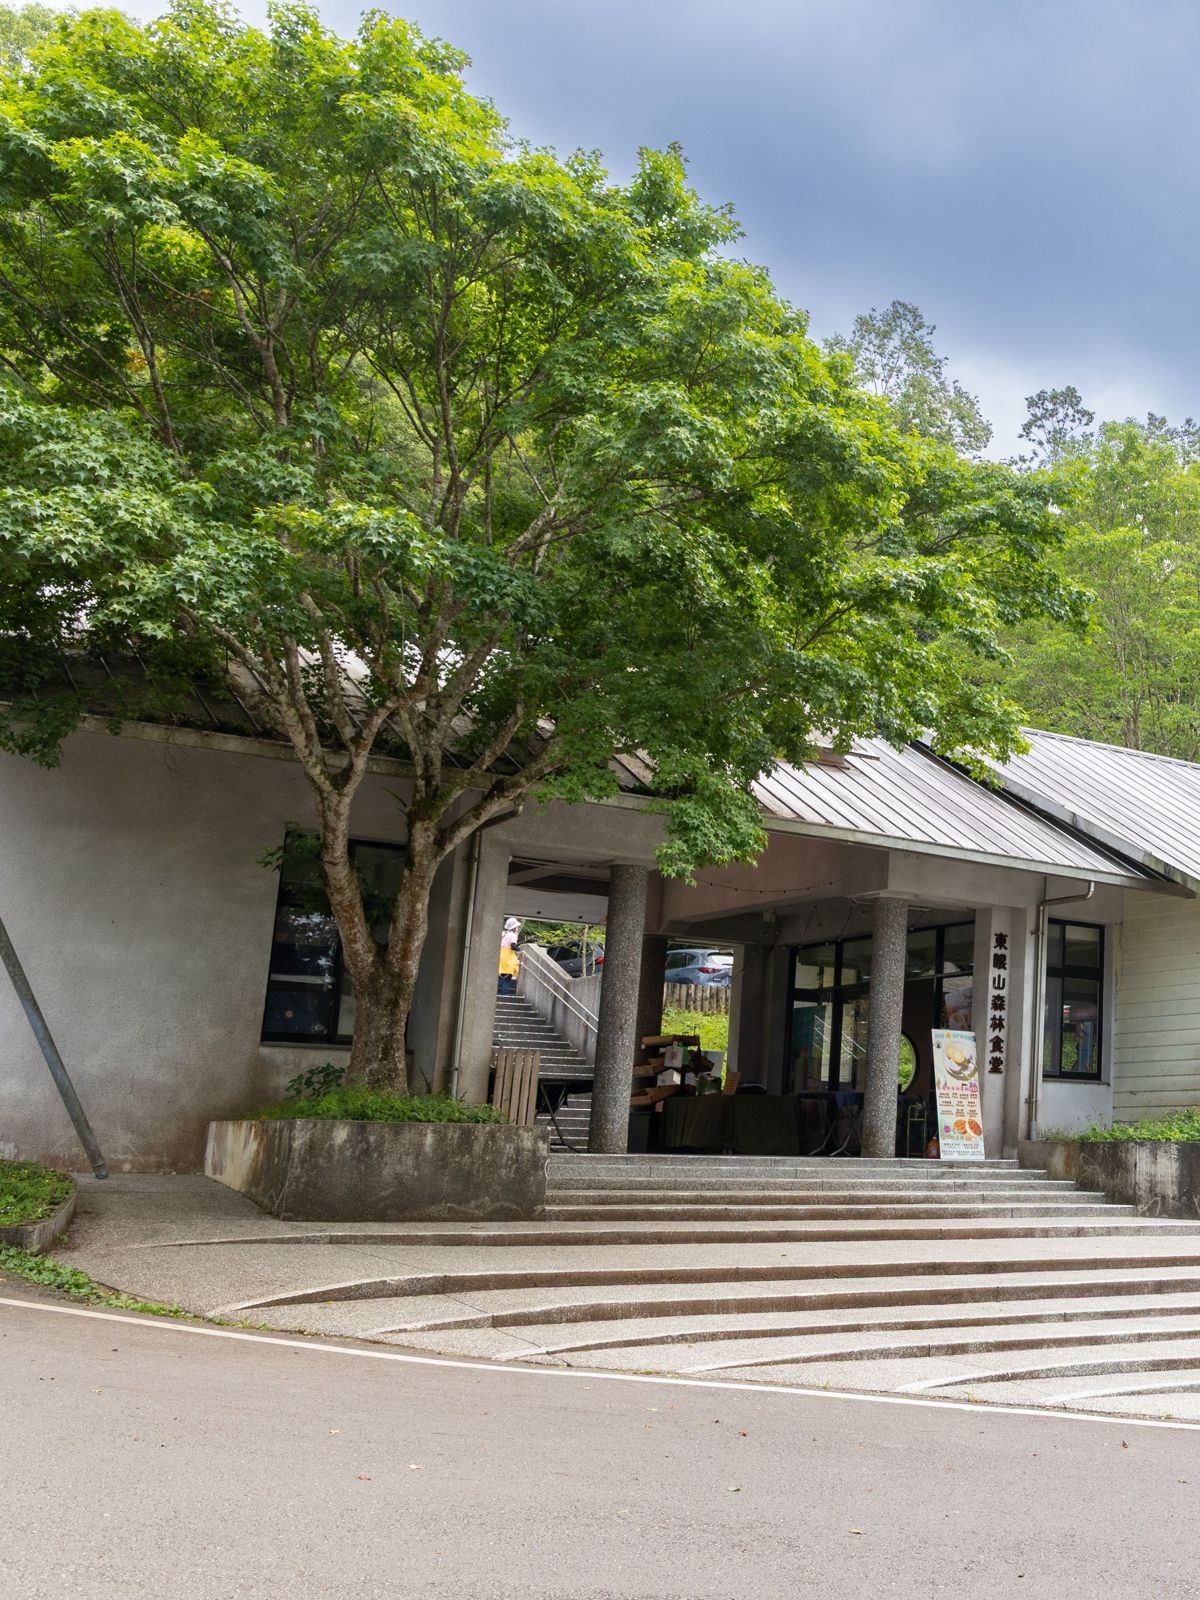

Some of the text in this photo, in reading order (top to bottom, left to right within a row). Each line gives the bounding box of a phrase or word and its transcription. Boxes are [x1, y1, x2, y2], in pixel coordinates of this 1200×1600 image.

[988, 932, 1009, 1074] 東眼山森林食堂
